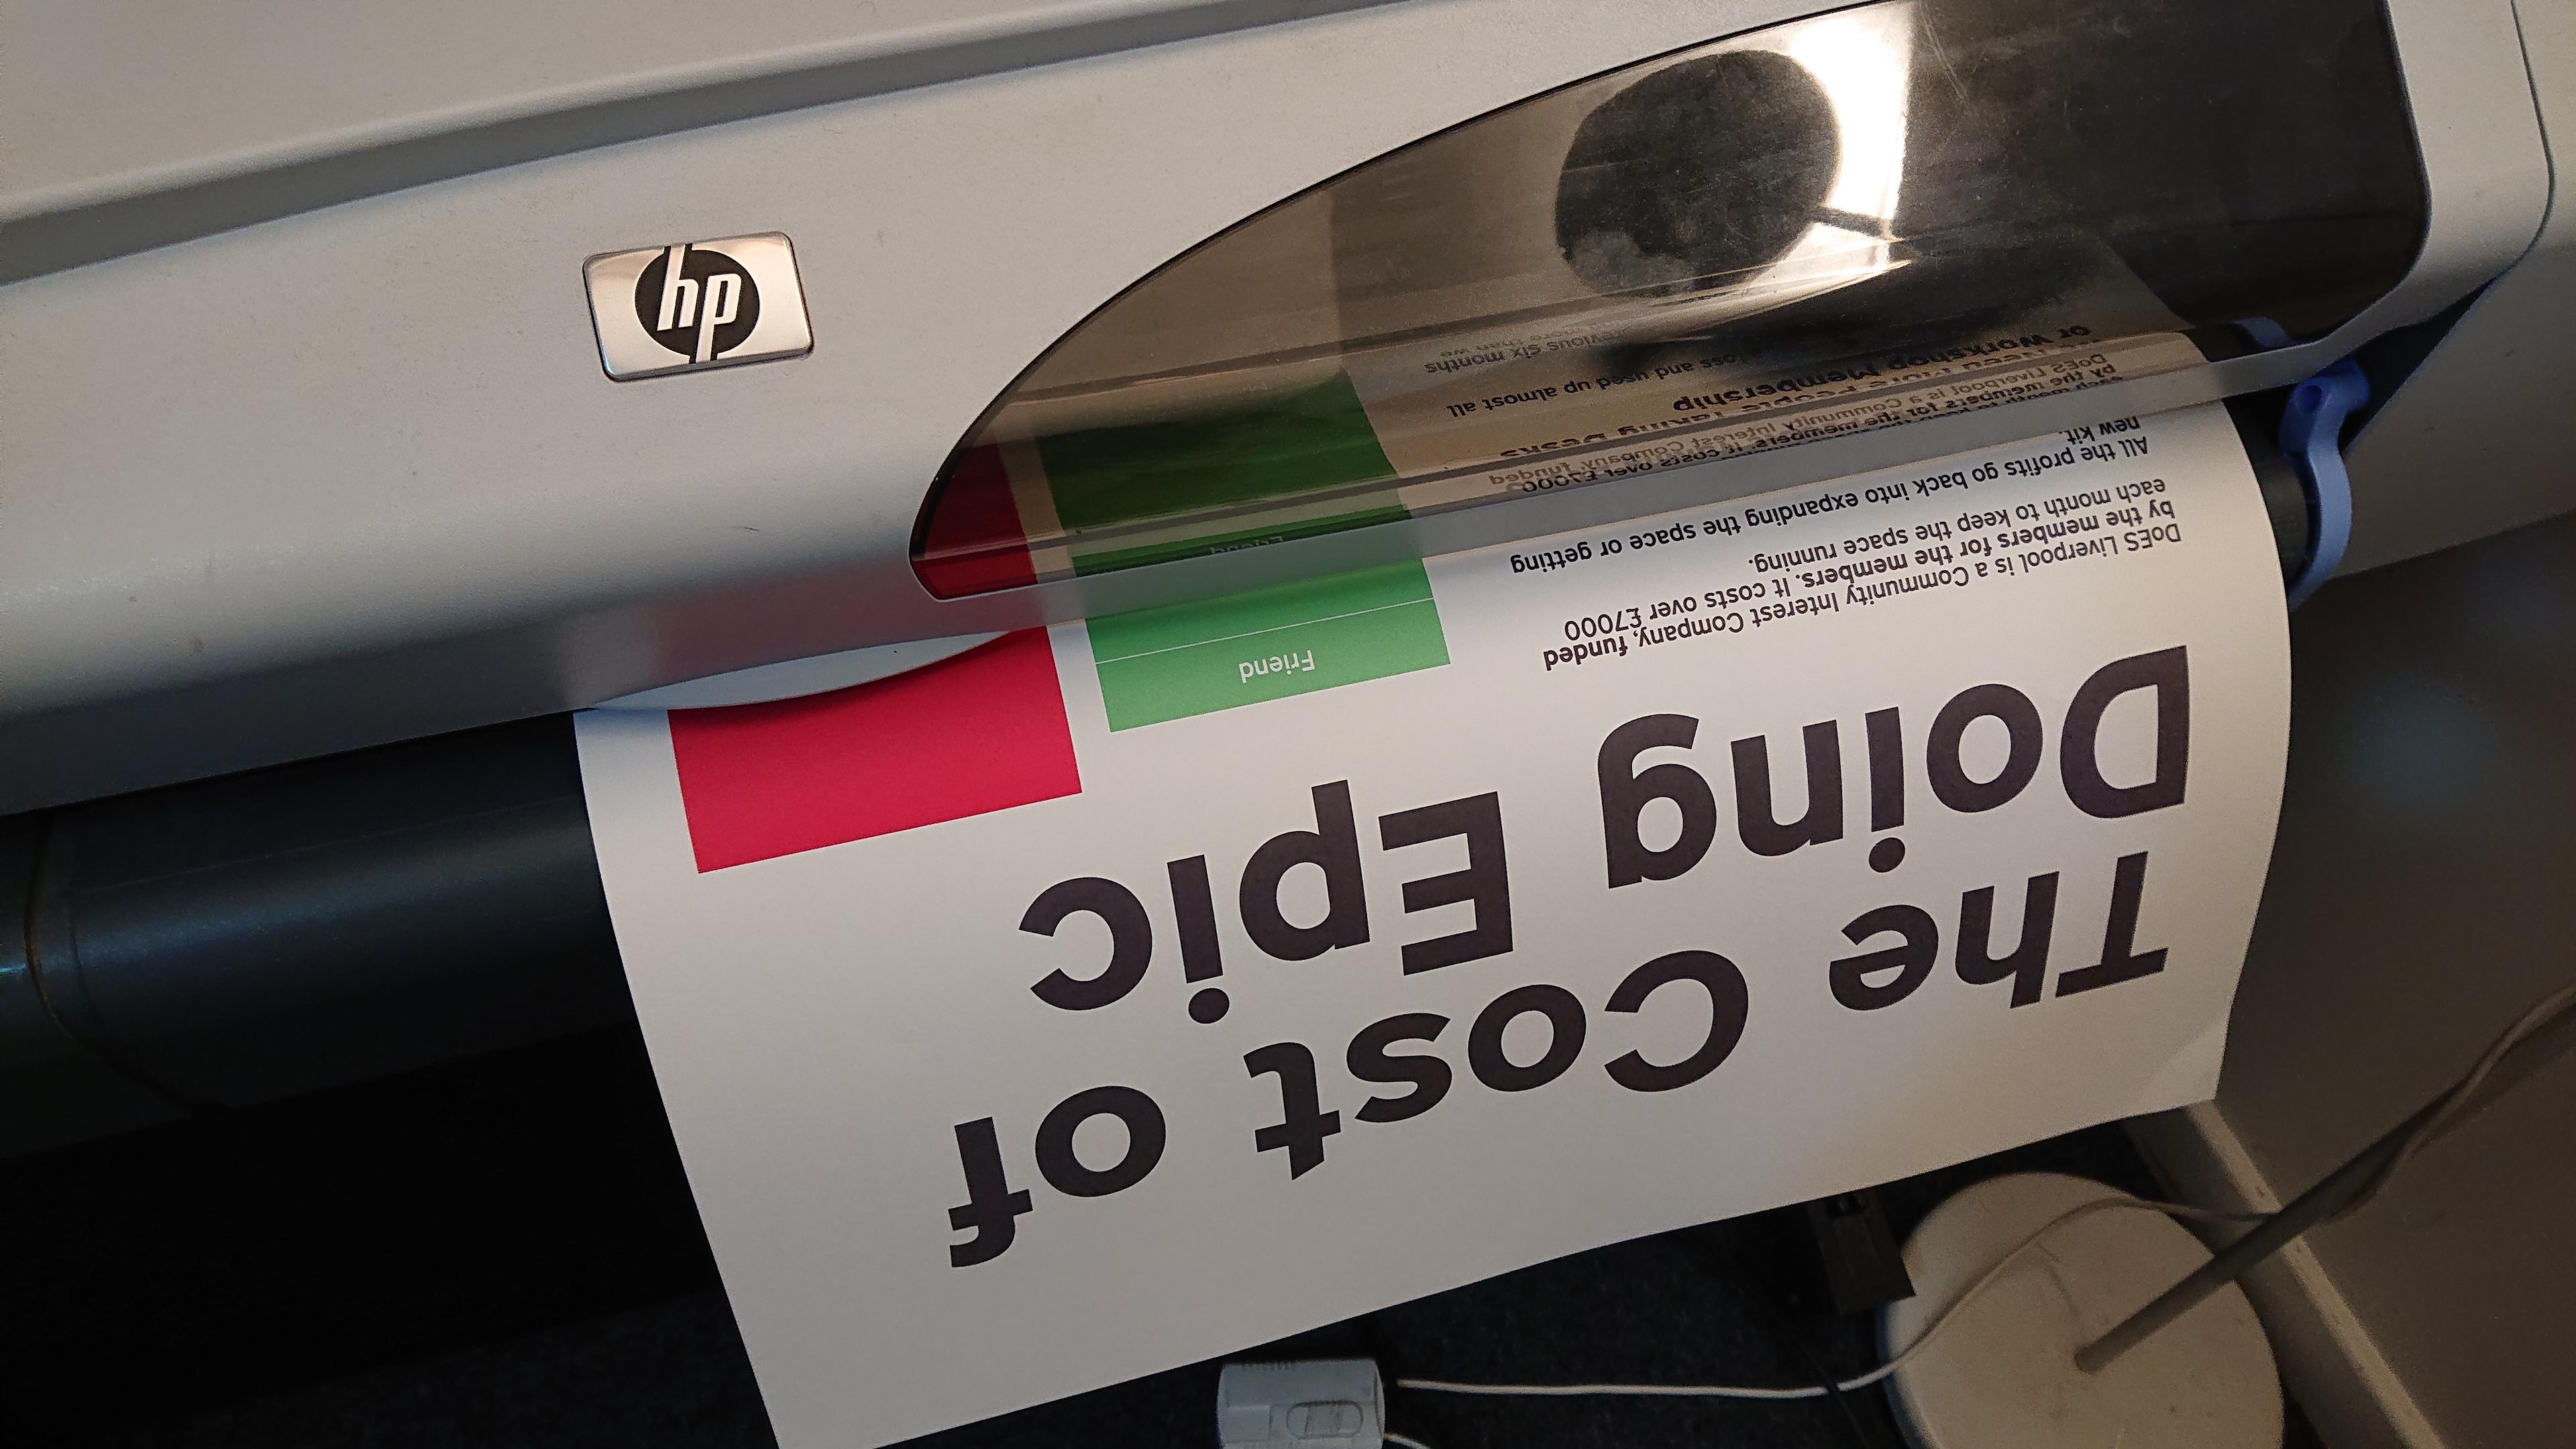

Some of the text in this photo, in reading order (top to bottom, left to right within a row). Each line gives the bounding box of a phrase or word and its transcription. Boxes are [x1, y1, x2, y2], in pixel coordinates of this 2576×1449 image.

[657, 244, 741, 363] hp
[1424, 351, 1503, 373] months
[1513, 344, 1541, 360] six
[1888, 335, 2053, 370] Workshop
[1564, 380, 1592, 394] up
[1596, 372, 1651, 390] used
[1655, 362, 1693, 380] and
[1673, 366, 1881, 411] Membership
[1447, 402, 1477, 417] all
[1482, 387, 1558, 411] almost
[2058, 416, 2141, 445] new kit.
[1509, 436, 2147, 574] All the profits go back into expanding the space or getting
[1748, 478, 2166, 574] each month to keep the space running.
[1564, 499, 2176, 641] by the members for the members. It costs over £7000
[1543, 523, 2182, 672] DoES Liverpool is a Community Interest Company, funded
[1238, 649, 1315, 684] Friend
[1018, 645, 2190, 1024] Doing Epic
[947, 851, 2169, 1268] The Cost of
